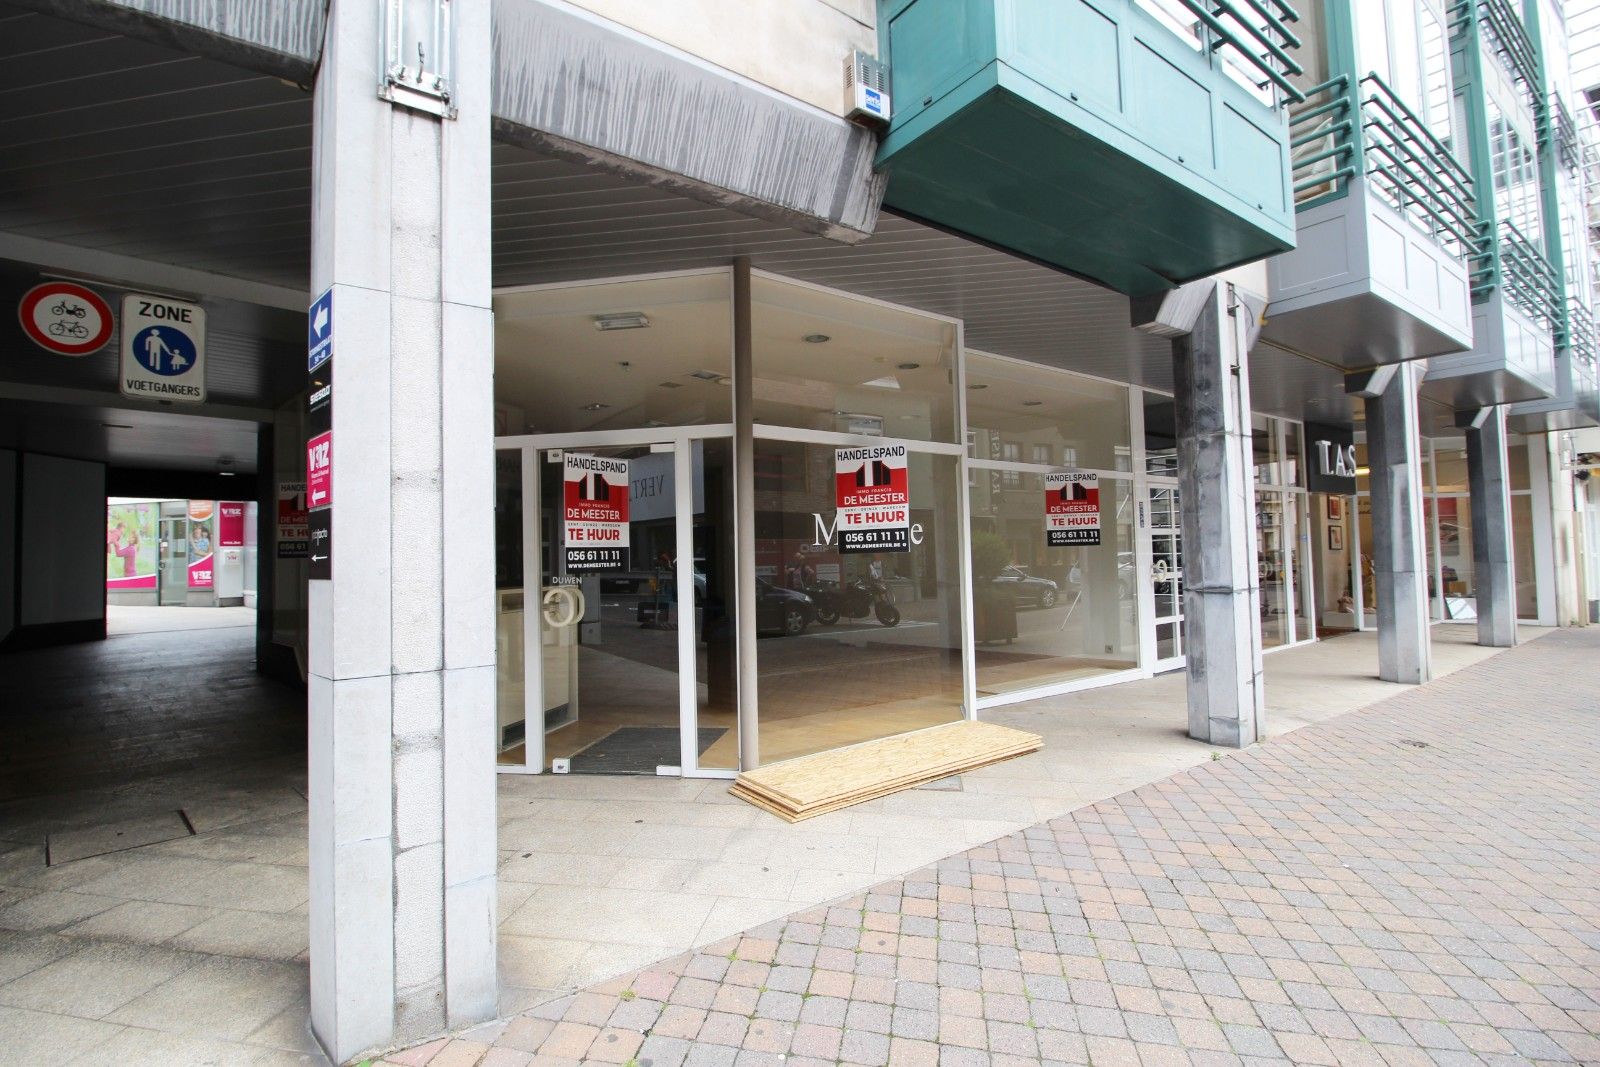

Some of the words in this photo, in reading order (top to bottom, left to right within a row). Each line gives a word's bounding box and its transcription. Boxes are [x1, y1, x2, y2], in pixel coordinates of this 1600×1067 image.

[139, 301, 192, 323] ZONE
[126, 379, 200, 397] VOETGANGERS
[837, 446, 905, 461] HANDELSPAND
[567, 457, 627, 474] HANDELSPAND
[1045, 473, 1097, 482] HANDELSPAND
[280, 483, 307, 492] HANDE
[844, 495, 857, 505] DE
[859, 492, 905, 504] MEESTER
[567, 507, 580, 518] DE
[581, 508, 620, 520] MEESTER
[1050, 505, 1061, 513] DE
[1062, 504, 1097, 512] MEESTER
[845, 513, 862, 524] TE
[865, 511, 905, 523] HUUR
[1051, 518, 1065, 526] TE
[1067, 517, 1098, 526] HUUR
[281, 529, 294, 537] TE
[568, 528, 584, 540] TE
[587, 529, 620, 540] HUUR
[845, 533, 864, 542] 056
[865, 532, 877, 541] 61
[881, 531, 891, 541] 11
[894, 531, 905, 541] 11
[568, 550, 586, 561] 056
[587, 550, 597, 561] 61
[600, 550, 609, 560] 11
[611, 550, 620, 560] 11
[552, 576, 582, 584] DUWEN
